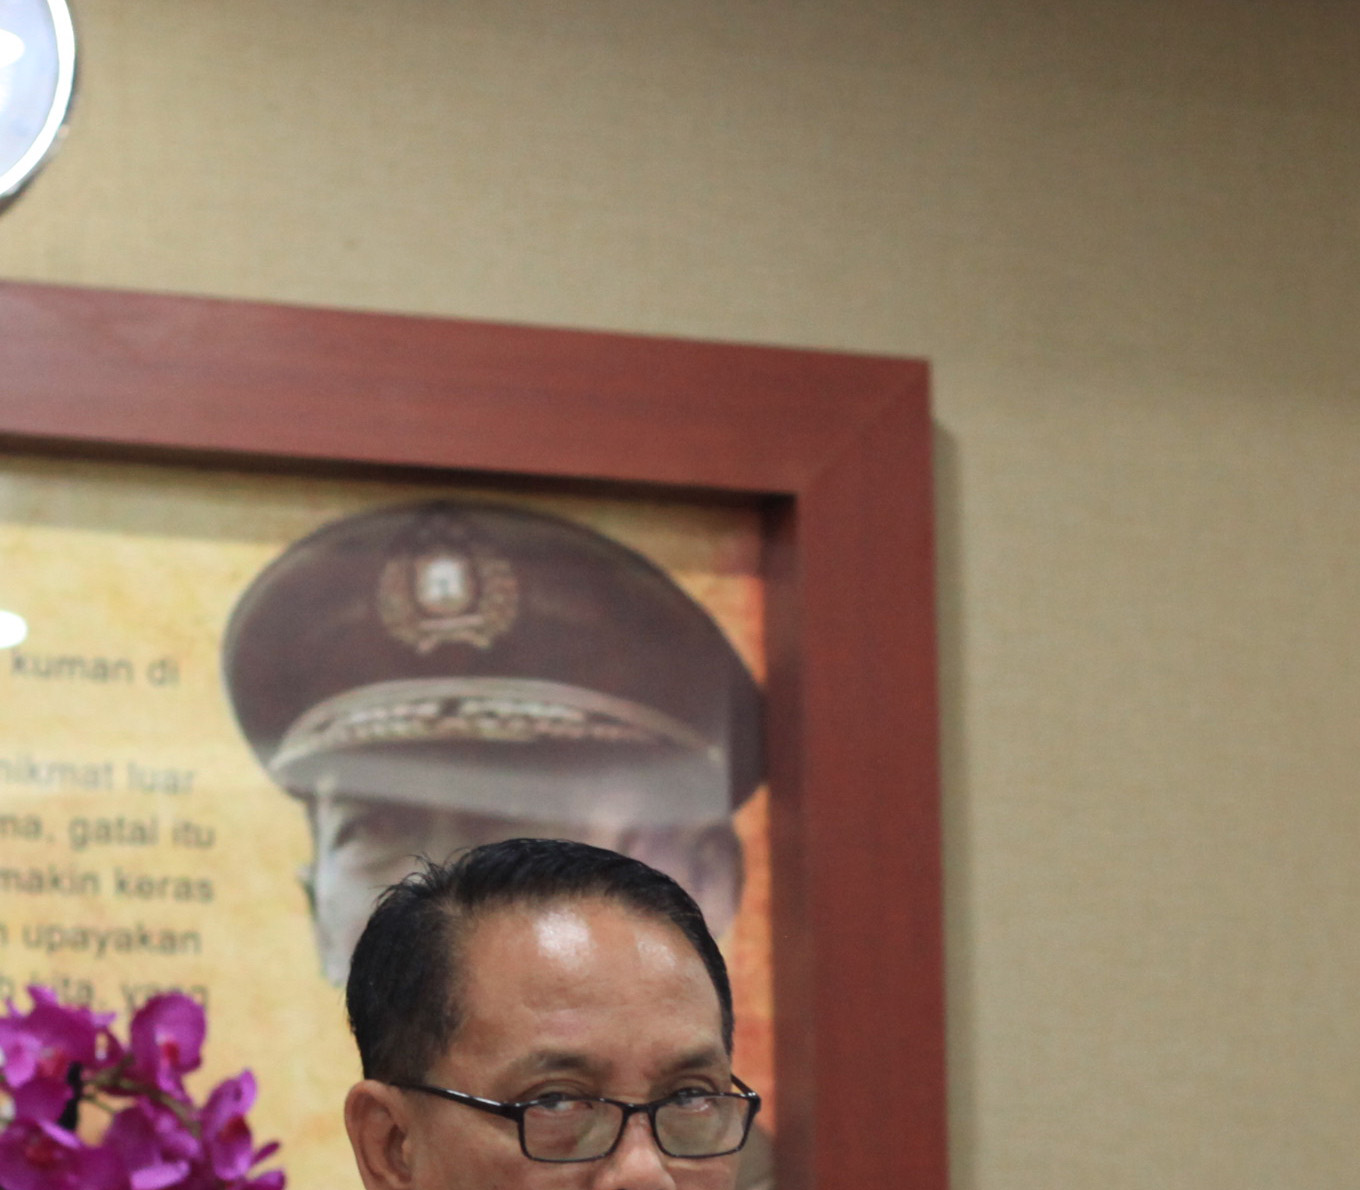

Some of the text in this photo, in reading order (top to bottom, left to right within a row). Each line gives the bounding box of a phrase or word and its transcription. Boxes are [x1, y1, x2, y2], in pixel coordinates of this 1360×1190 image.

[11, 650, 134, 686] kuman
[146, 655, 181, 689] di
[127, 761, 198, 797] luar
[68, 814, 159, 853] gatal
[171, 820, 216, 850] itu
[114, 866, 215, 905] keras
[22, 920, 203, 962] upayakan
